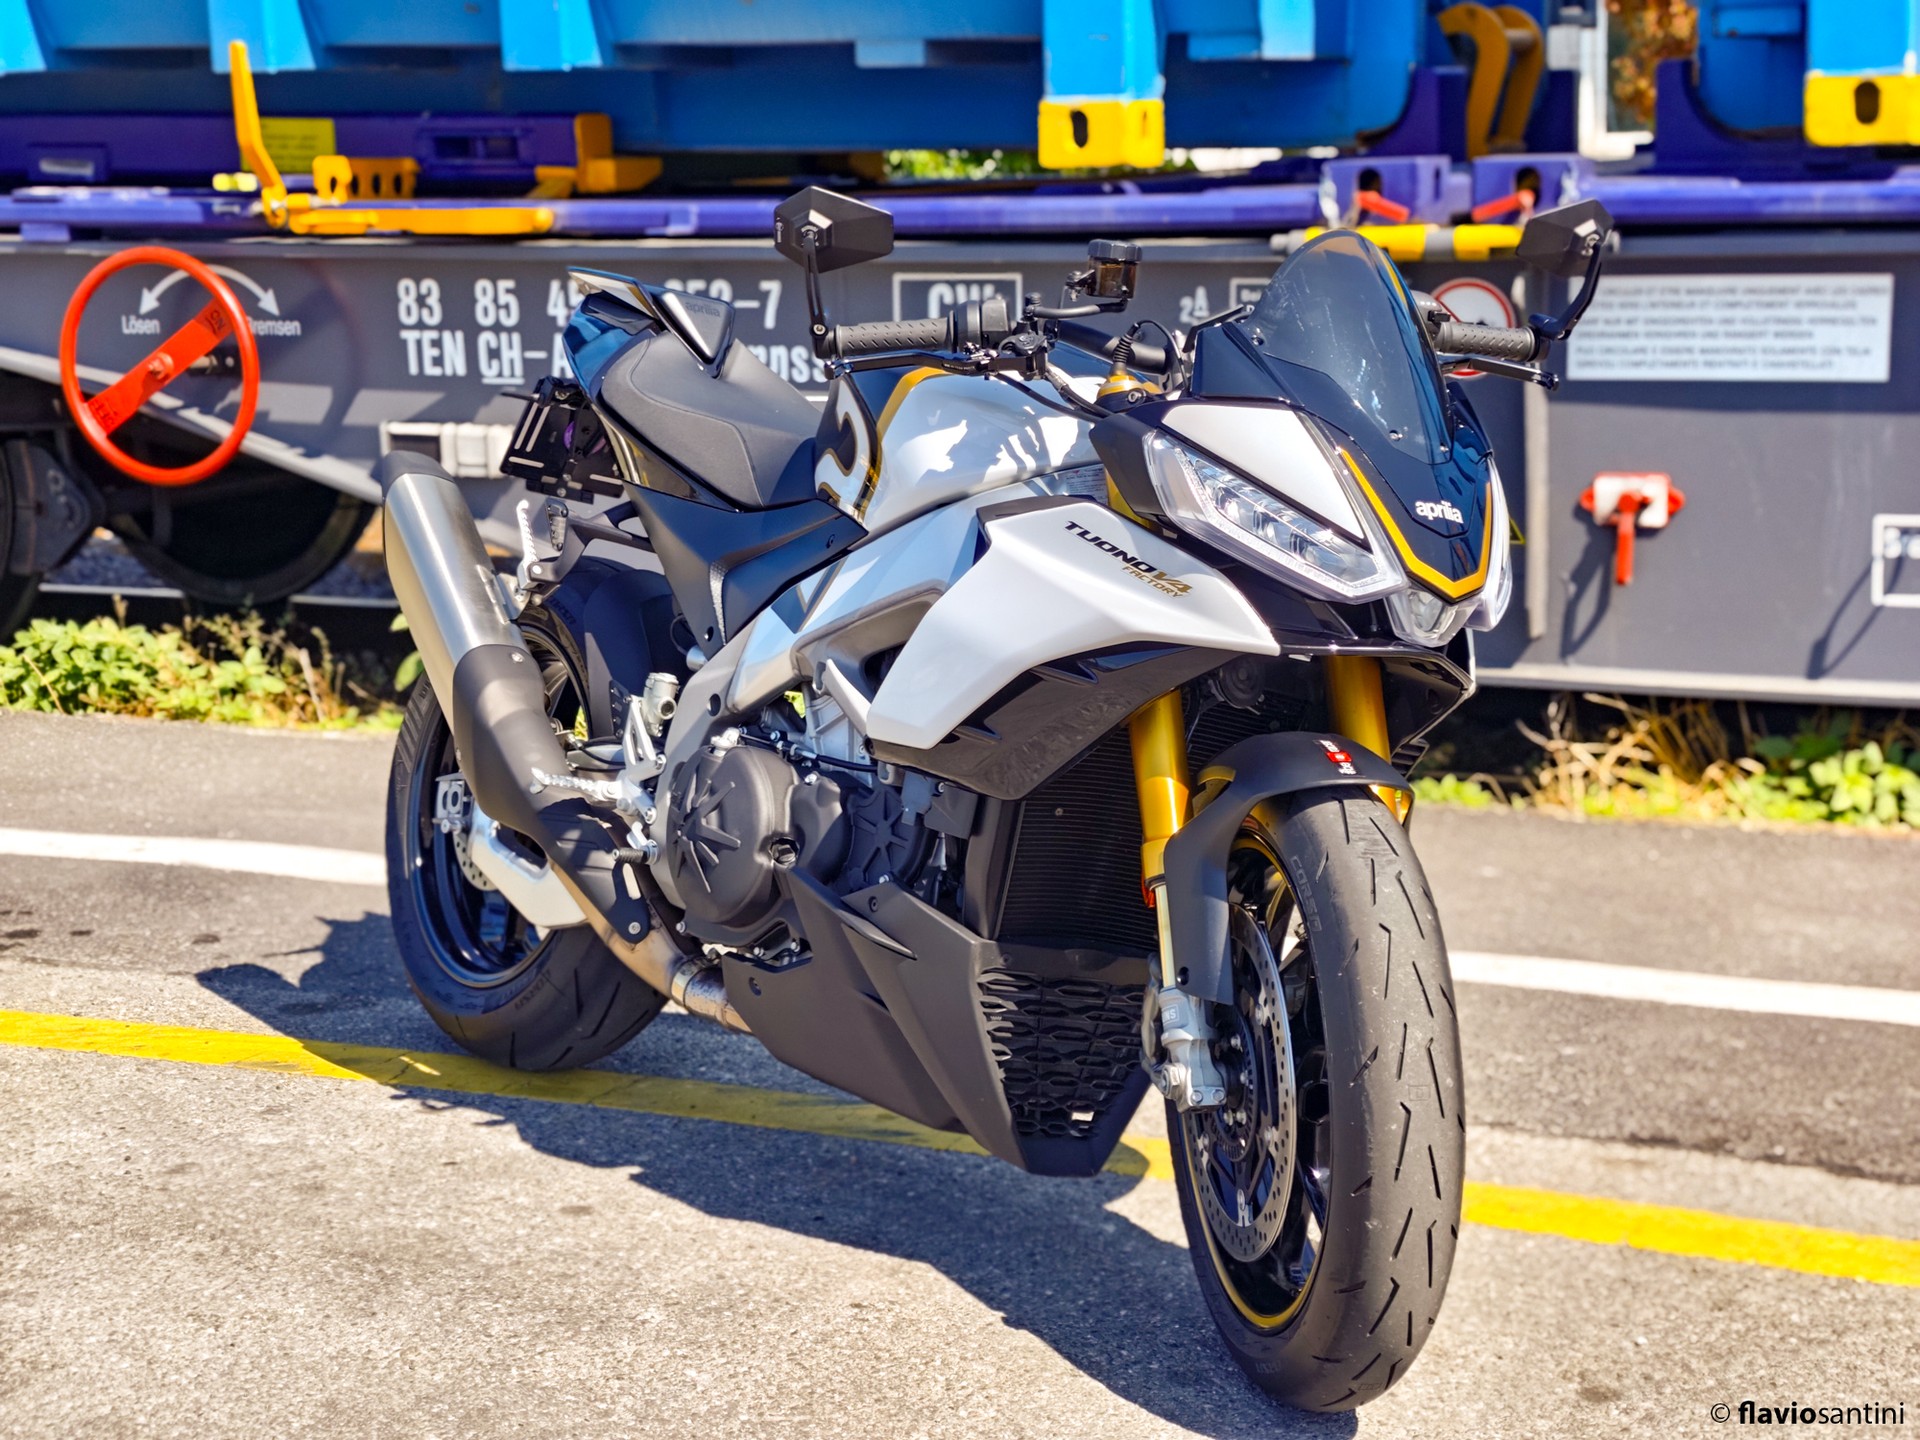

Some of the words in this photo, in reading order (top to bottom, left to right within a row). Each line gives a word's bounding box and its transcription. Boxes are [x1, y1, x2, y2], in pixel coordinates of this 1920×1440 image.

[397, 278, 442, 326] 83
[474, 278, 520, 327] 85
[121, 315, 161, 335] Lösen
[400, 330, 467, 377] TEN
[1415, 500, 1464, 524] aprilia
[1065, 521, 1157, 573] TUONO
[1153, 571, 1193, 593] V4
[1122, 566, 1182, 597] FACTORY
